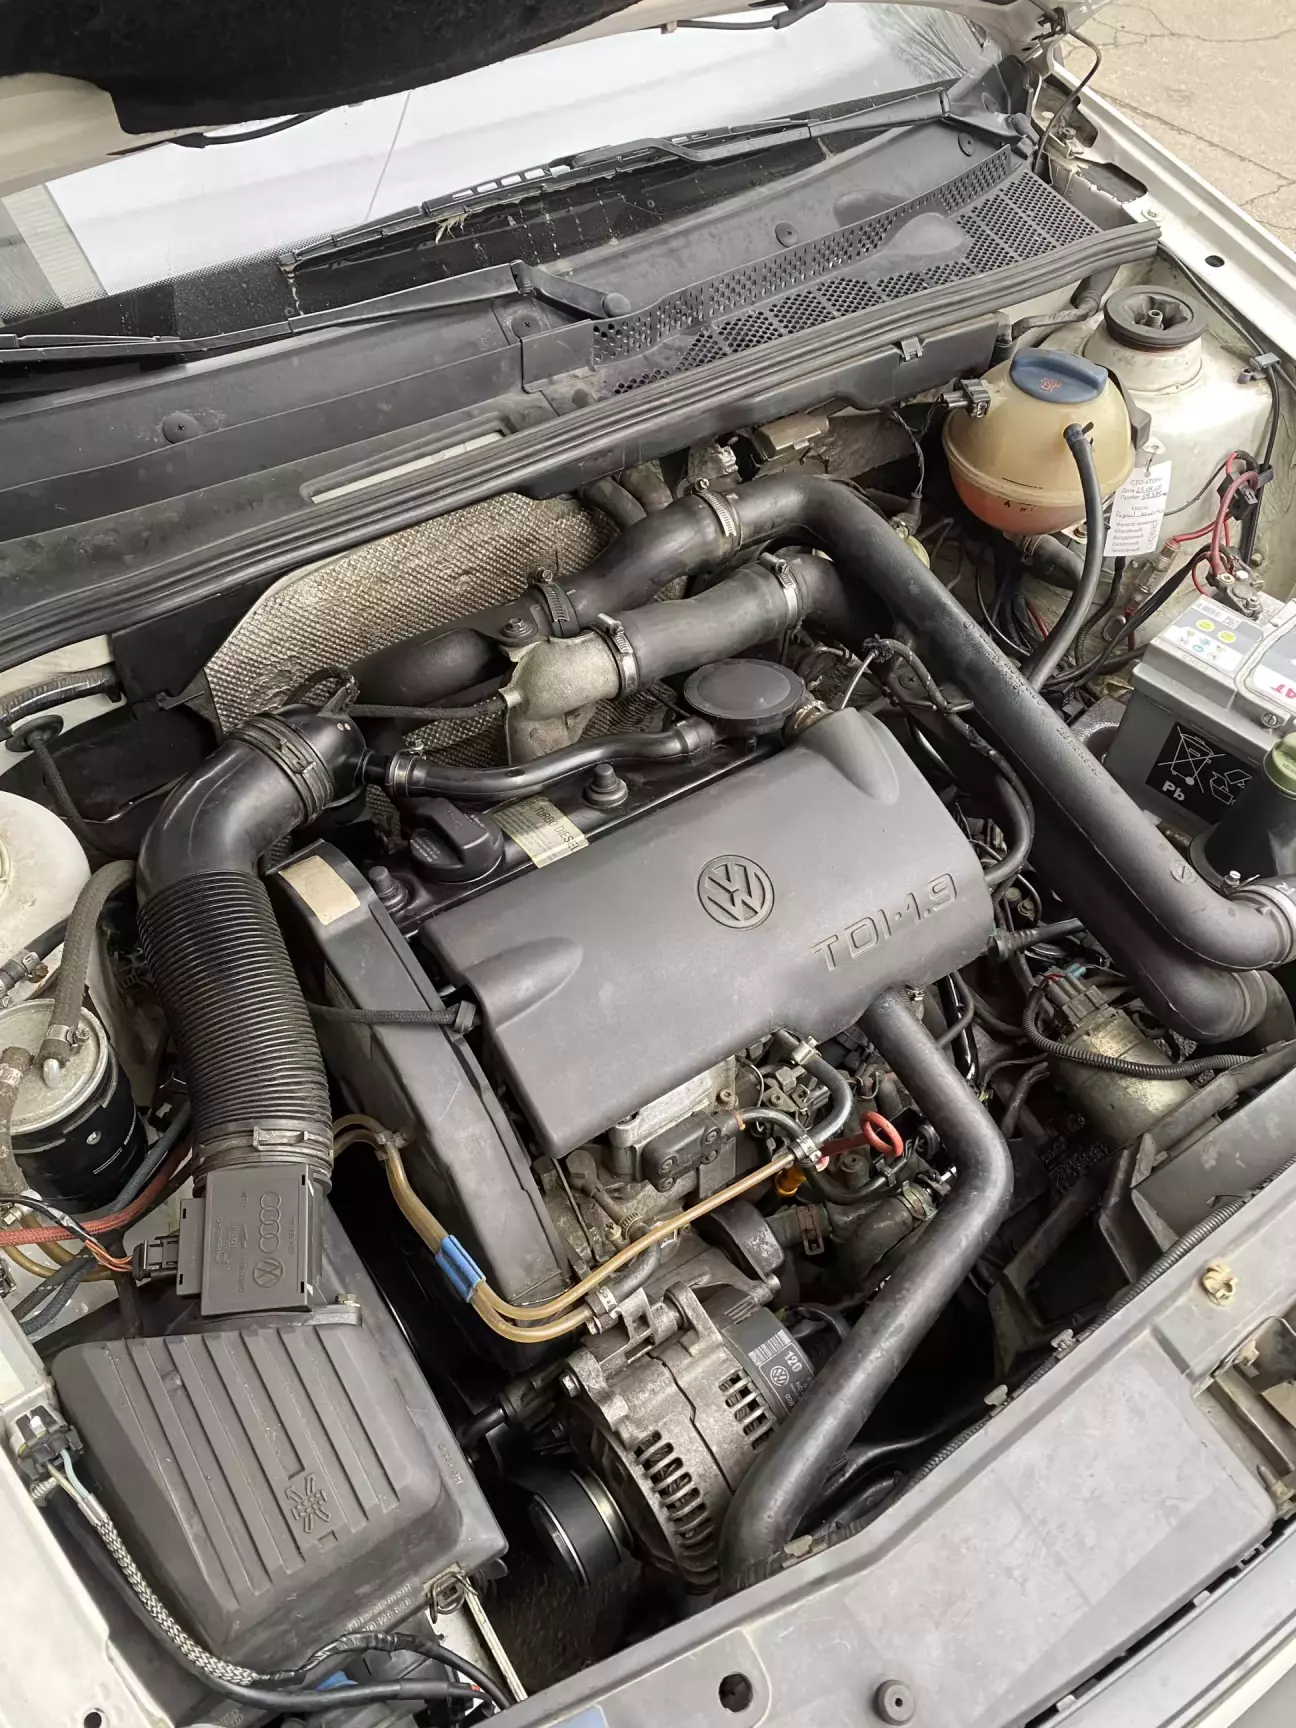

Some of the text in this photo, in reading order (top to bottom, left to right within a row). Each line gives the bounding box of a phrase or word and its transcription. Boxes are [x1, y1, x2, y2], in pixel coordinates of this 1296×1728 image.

[1162, 780, 1185, 801] Pb
[534, 806, 559, 826] TURBO
[555, 825, 580, 853] DIESEL
[785, 1351, 802, 1372] 120
